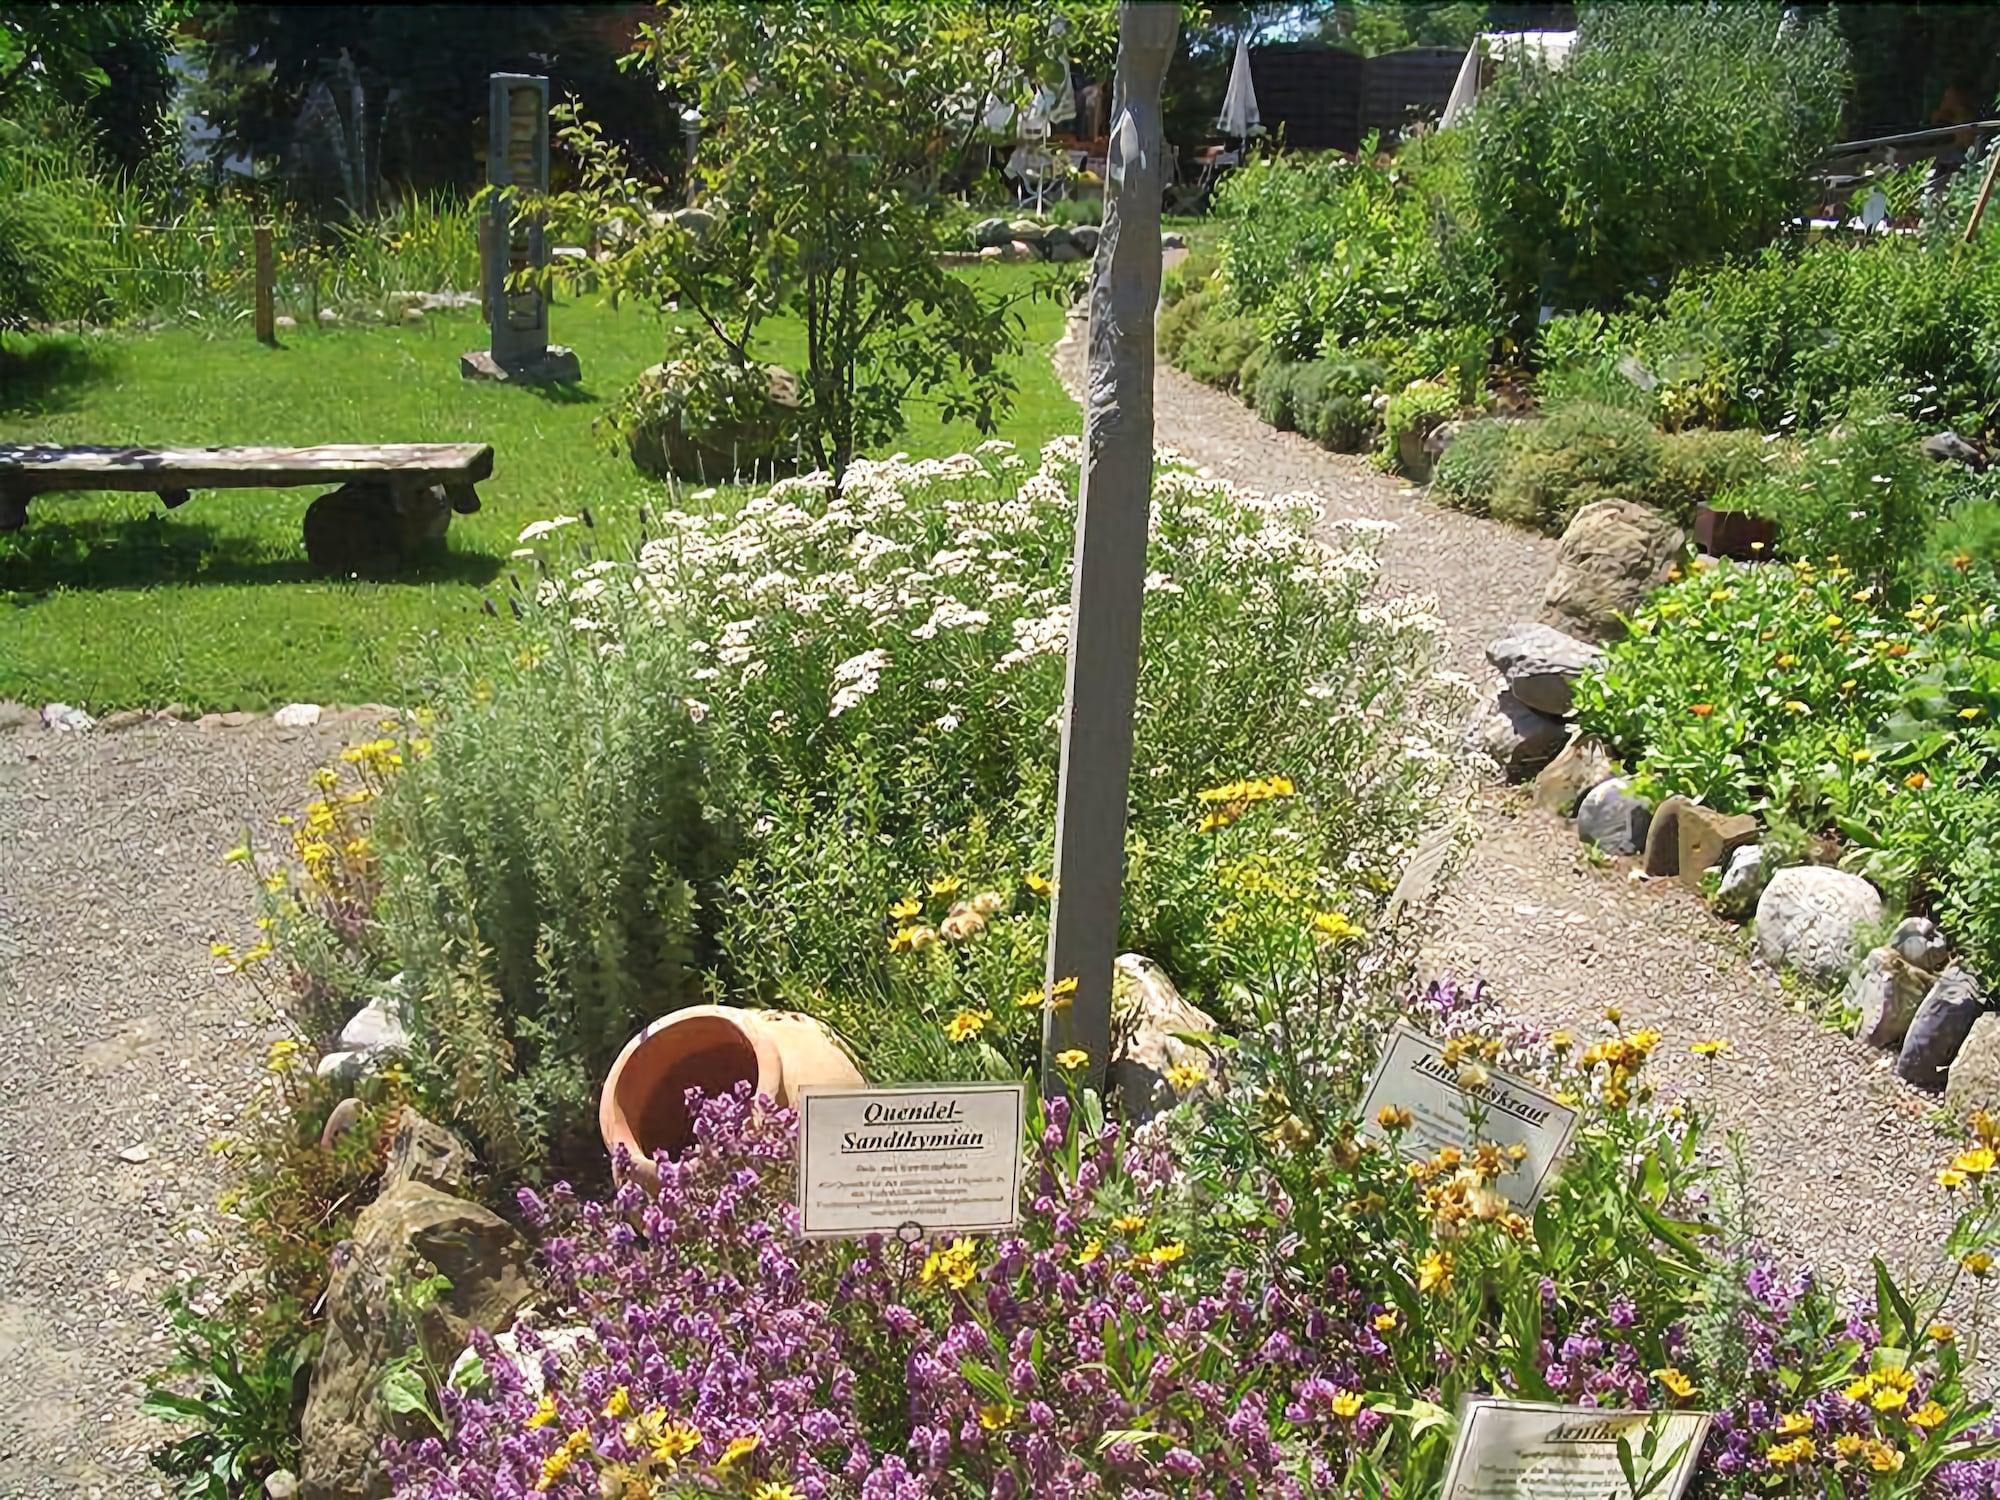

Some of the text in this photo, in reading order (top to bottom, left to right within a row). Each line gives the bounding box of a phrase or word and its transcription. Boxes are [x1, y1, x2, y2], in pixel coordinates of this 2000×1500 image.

[1411, 1054, 1550, 1123] Johaniskraut
[864, 1100, 963, 1123] Quendel-
[842, 1129, 983, 1150] Sandthymian
